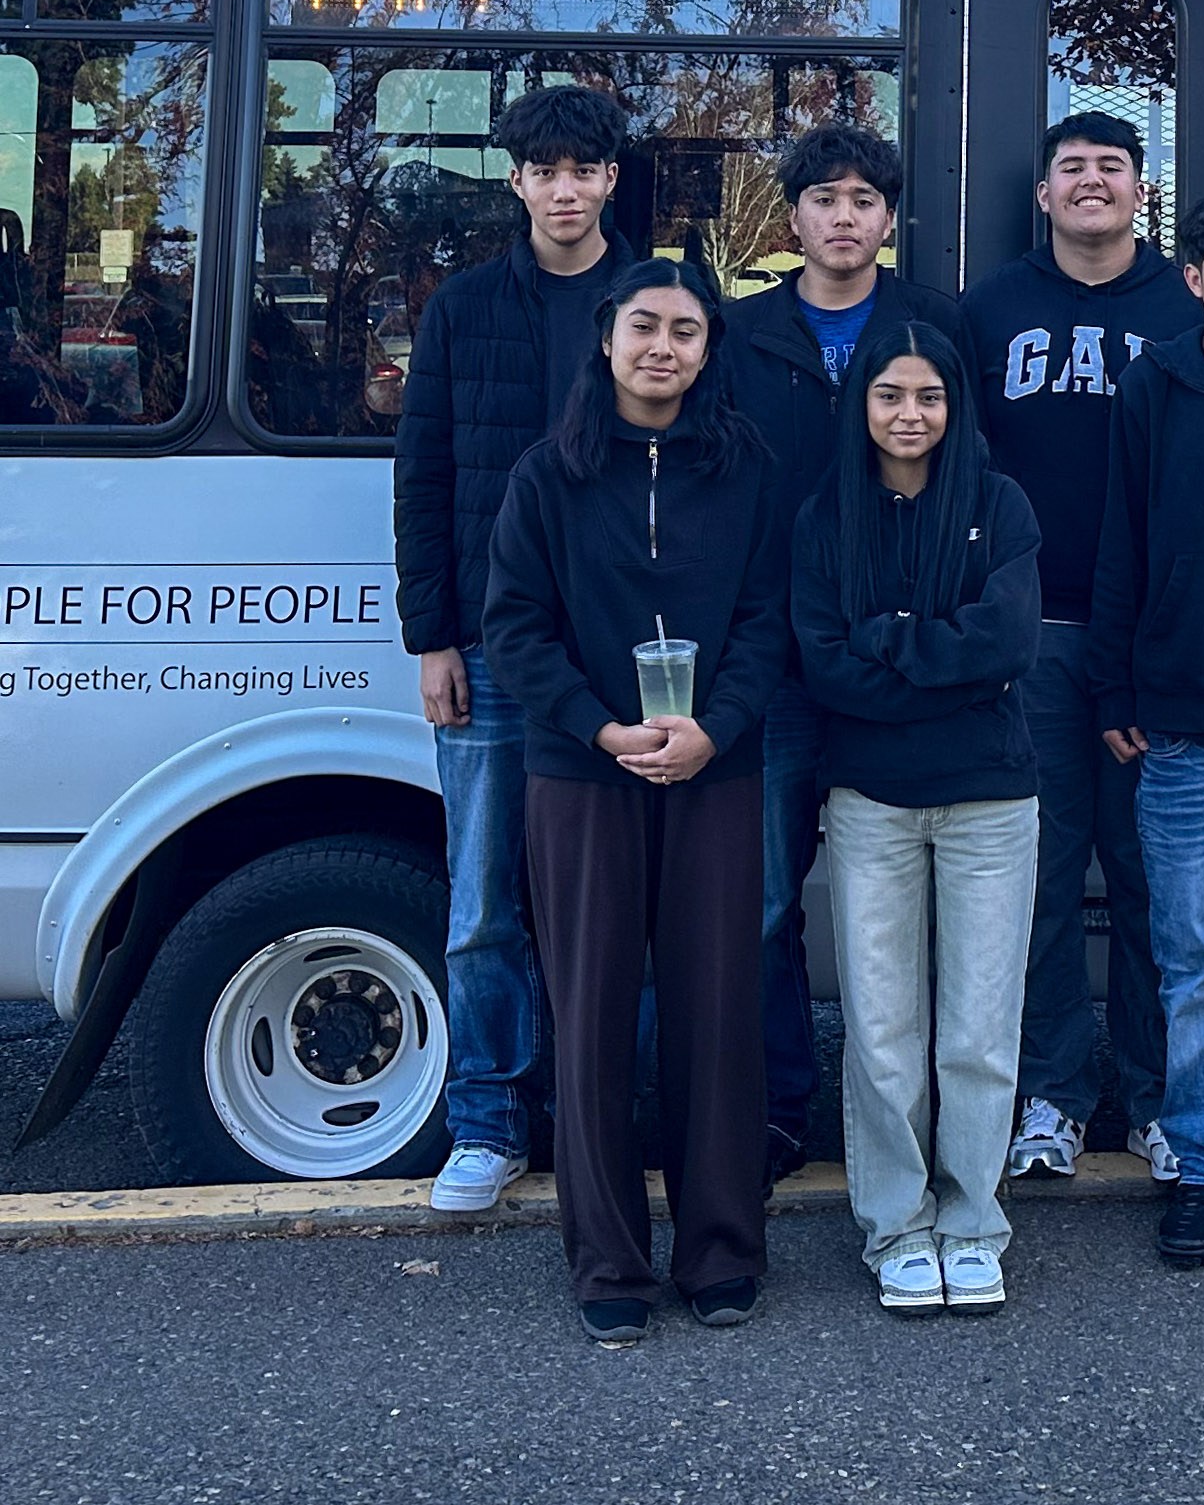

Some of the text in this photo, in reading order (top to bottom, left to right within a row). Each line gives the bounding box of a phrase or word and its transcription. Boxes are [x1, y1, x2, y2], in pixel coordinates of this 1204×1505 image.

[4, 585, 382, 625] PLE FOR PEOPLE
[22, 665, 152, 697] Together,
[159, 664, 294, 696] Changing
[303, 665, 370, 690] Lives
